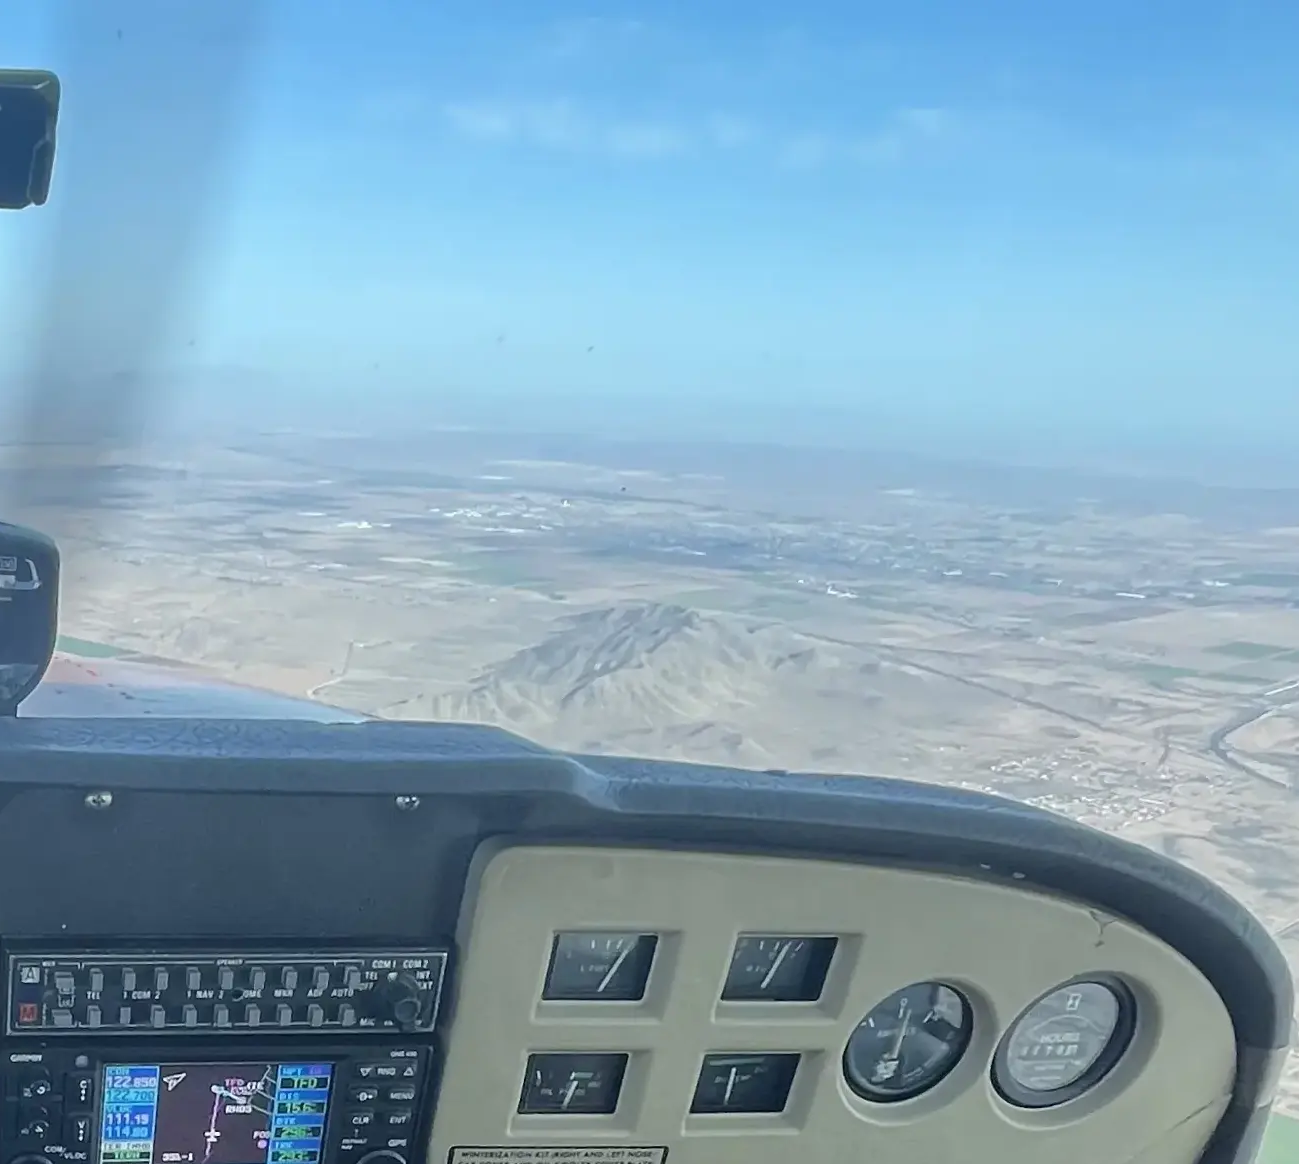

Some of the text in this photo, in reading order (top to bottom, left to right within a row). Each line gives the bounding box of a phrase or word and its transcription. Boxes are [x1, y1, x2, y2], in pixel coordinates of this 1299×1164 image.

[25, 968, 37, 980] A
[292, 1078, 317, 1088] TFD
[352, 1116, 370, 1125] CLR
[389, 1116, 407, 1125] ENT
